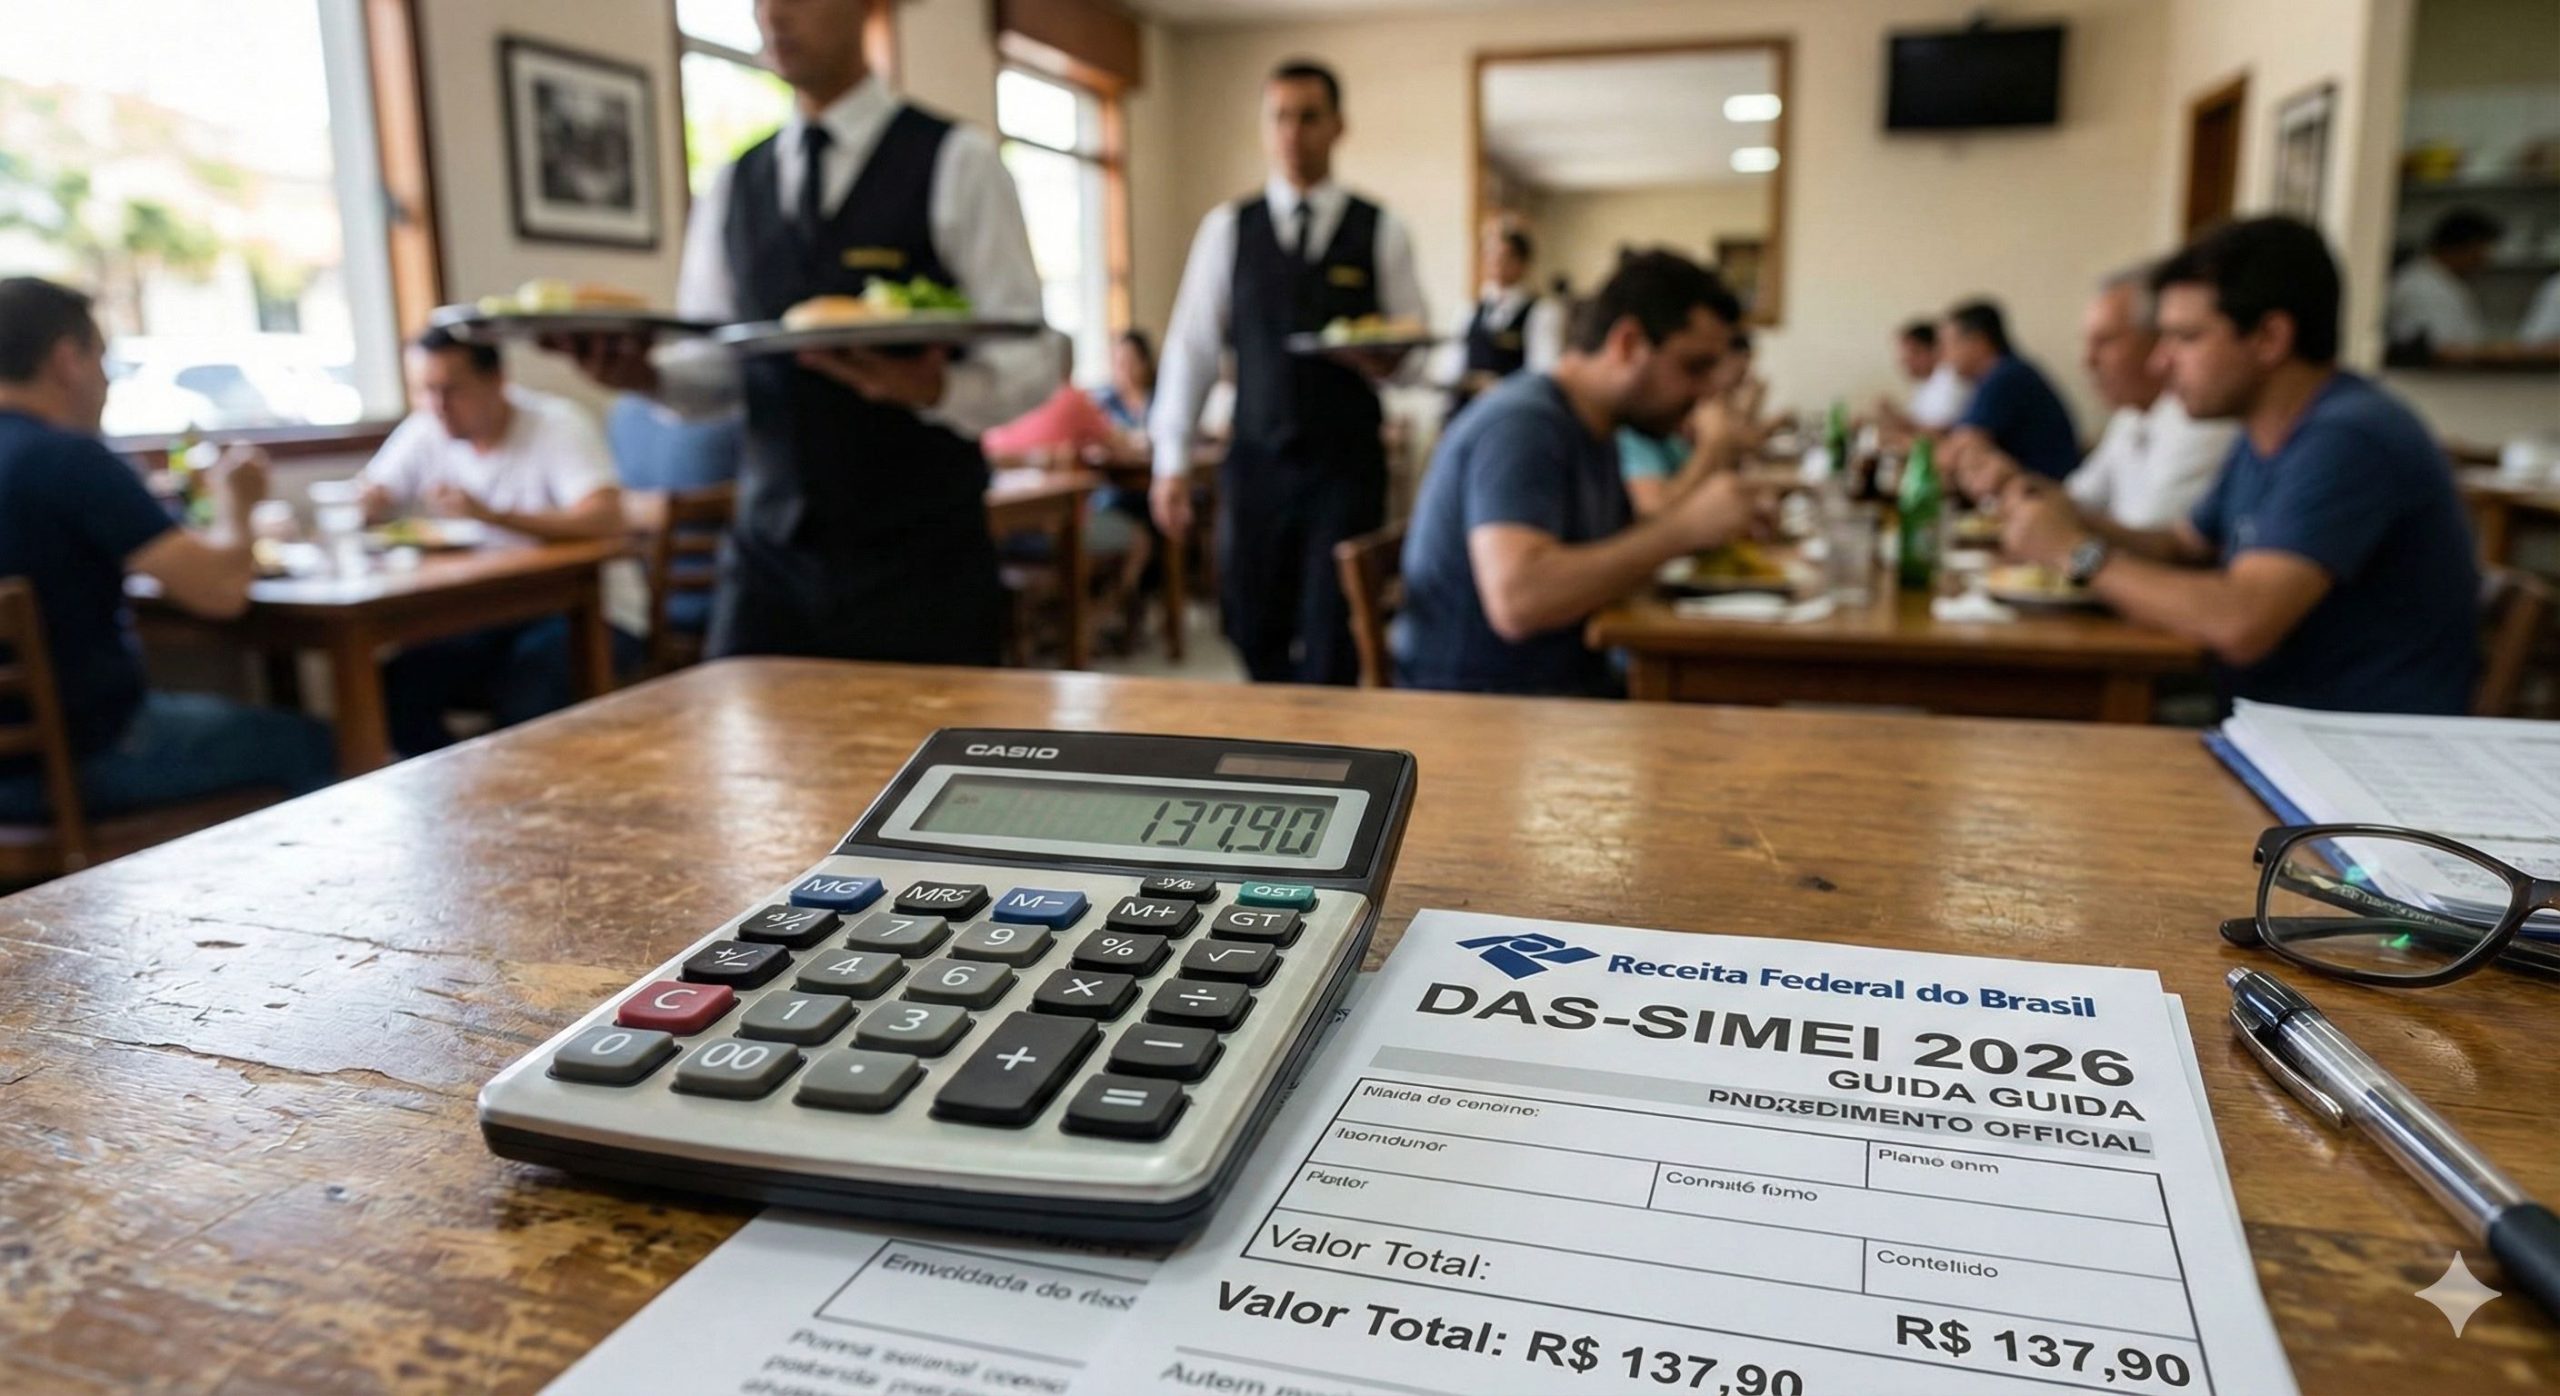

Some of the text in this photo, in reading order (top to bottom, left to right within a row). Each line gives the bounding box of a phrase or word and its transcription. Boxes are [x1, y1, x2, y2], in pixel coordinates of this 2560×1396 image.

[965, 744, 1059, 759] CASIO
[1120, 902, 1176, 918] M+
[1229, 912, 1281, 927] GT
[880, 920, 914, 937] 7
[984, 928, 1015, 946] 9
[1102, 938, 1133, 956] %
[828, 957, 863, 975] 4
[942, 966, 976, 986] 6
[1607, 954, 2096, 1018] Receita Federal do Brasil
[654, 990, 697, 1010] C
[783, 1000, 808, 1021] 1
[888, 1009, 929, 1032] 3
[592, 1034, 632, 1055] 0
[1415, 982, 2137, 1087] DAS-SIMEI 2026
[700, 1043, 769, 1070] 00
[1828, 1070, 2147, 1121] GUIDA GUIDA
[1984, 1120, 2151, 1154] OFFICIAL
[1271, 1224, 1491, 1280] Valor Total:
[1218, 1280, 1804, 1396] Valor Total: R$ 137,90
[1895, 1314, 2192, 1387] R$ 137,90
